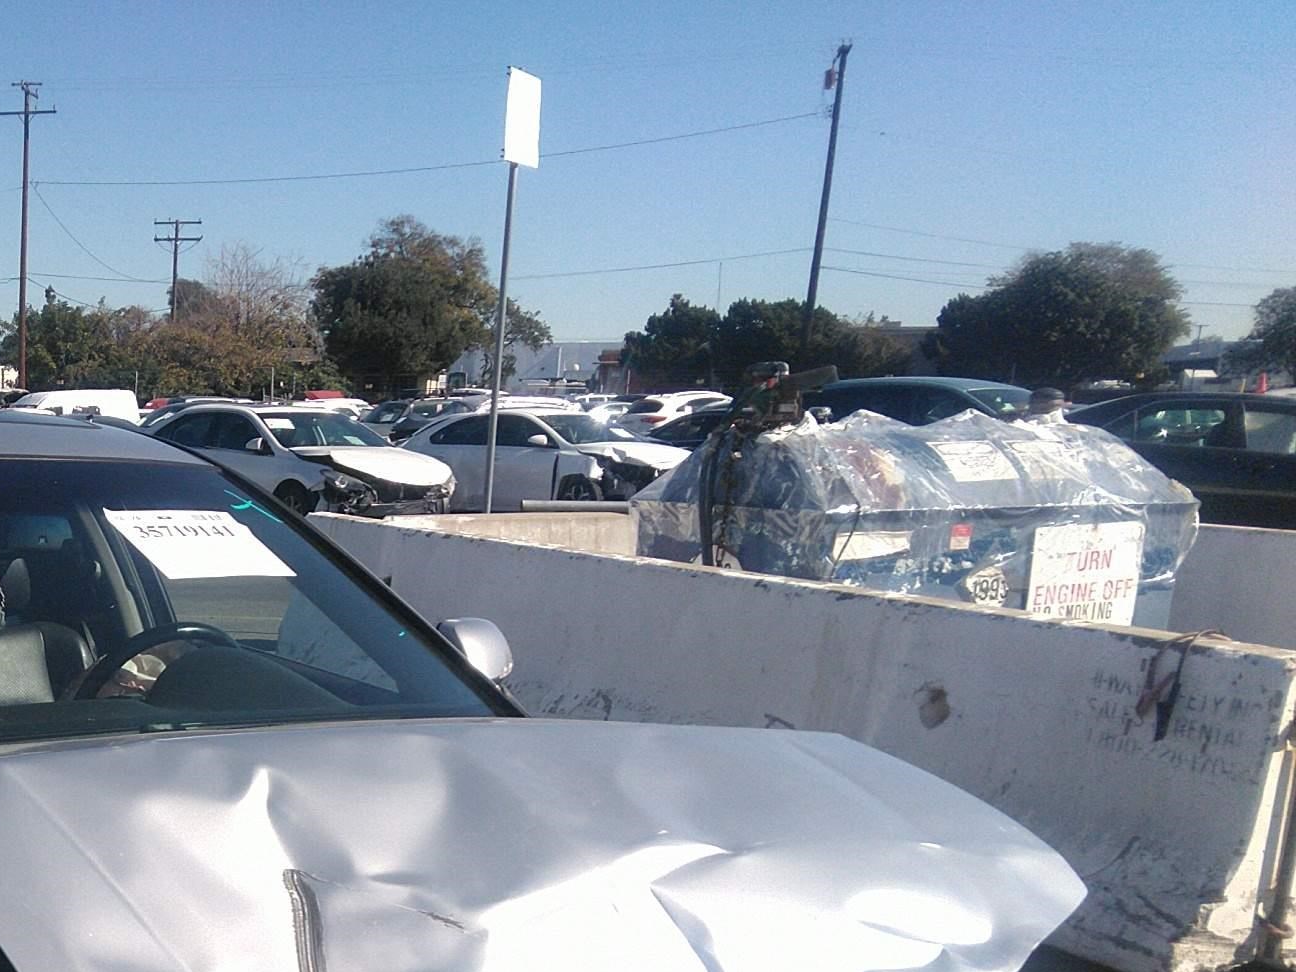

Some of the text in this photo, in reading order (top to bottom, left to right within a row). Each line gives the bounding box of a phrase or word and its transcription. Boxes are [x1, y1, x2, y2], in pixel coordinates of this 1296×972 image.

[132, 525, 236, 539] 35719141
[1067, 549, 1113, 572] TURN
[1033, 578, 1134, 606] ENGINE OFF
[1058, 601, 1113, 621] SMOKING
